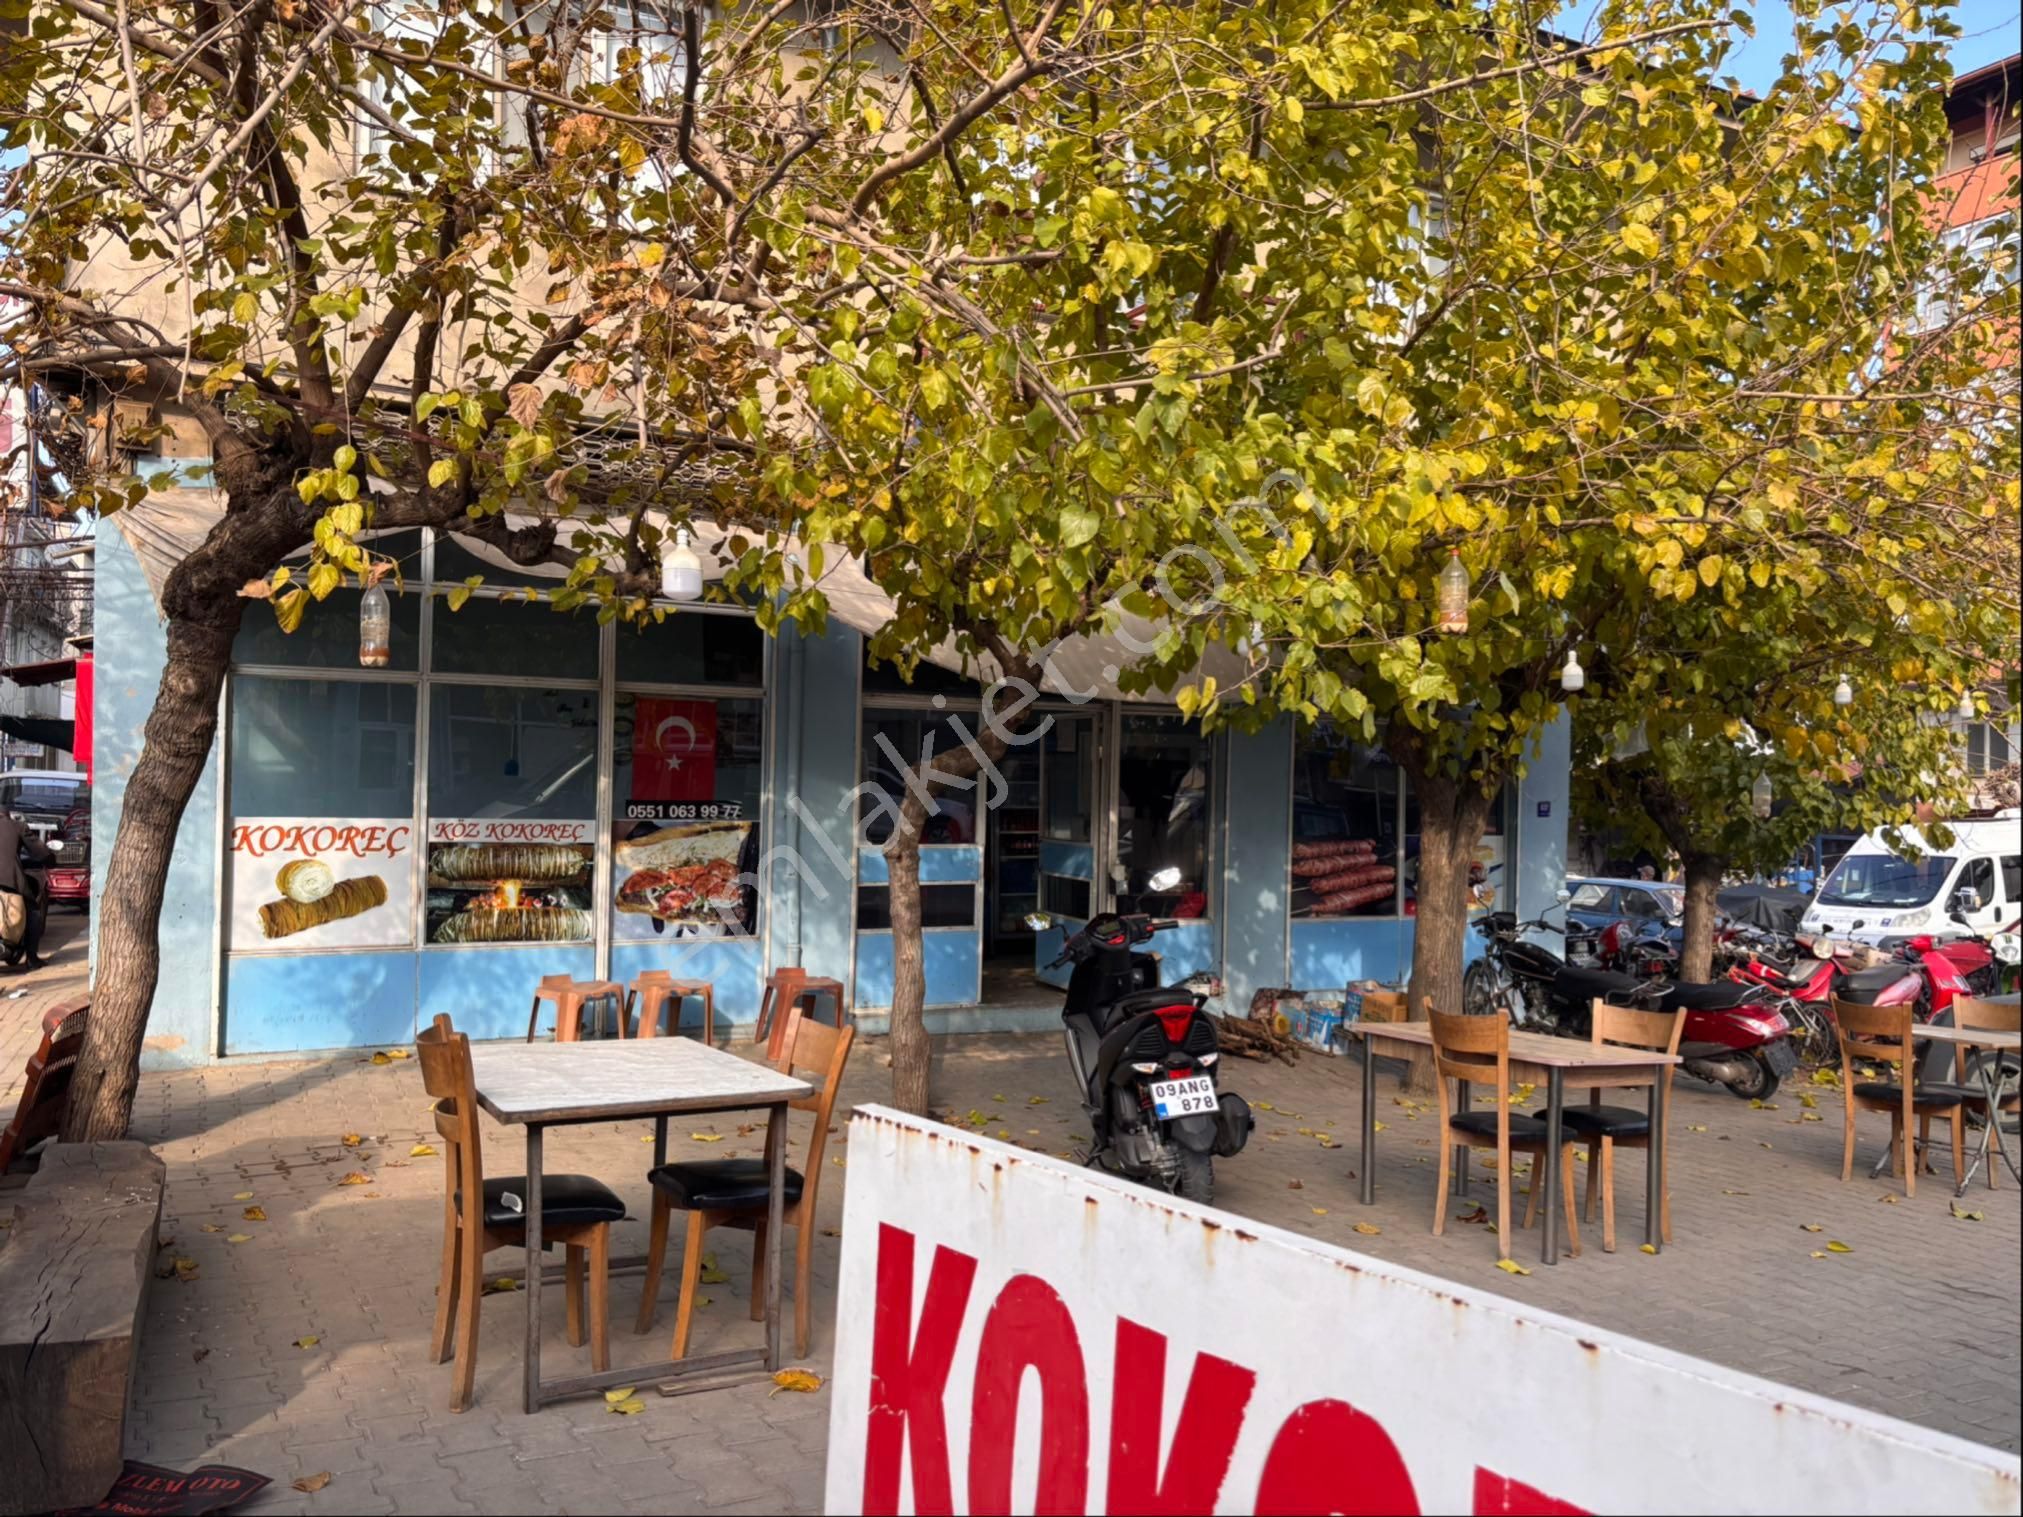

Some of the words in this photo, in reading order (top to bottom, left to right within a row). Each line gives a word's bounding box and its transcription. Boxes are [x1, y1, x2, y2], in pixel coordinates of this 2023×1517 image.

[627, 805, 663, 818] 0551
[669, 805, 696, 818] 063
[700, 805, 719, 818] 99
[434, 818, 480, 841] KÖZ
[485, 823, 585, 842] KOKOREÇ
[229, 825, 410, 858] KOKOREÇ
[1155, 1080, 1209, 1098] 09ANG
[1182, 1096, 1214, 1112] 878
[188, 1476, 241, 1490] OTO
